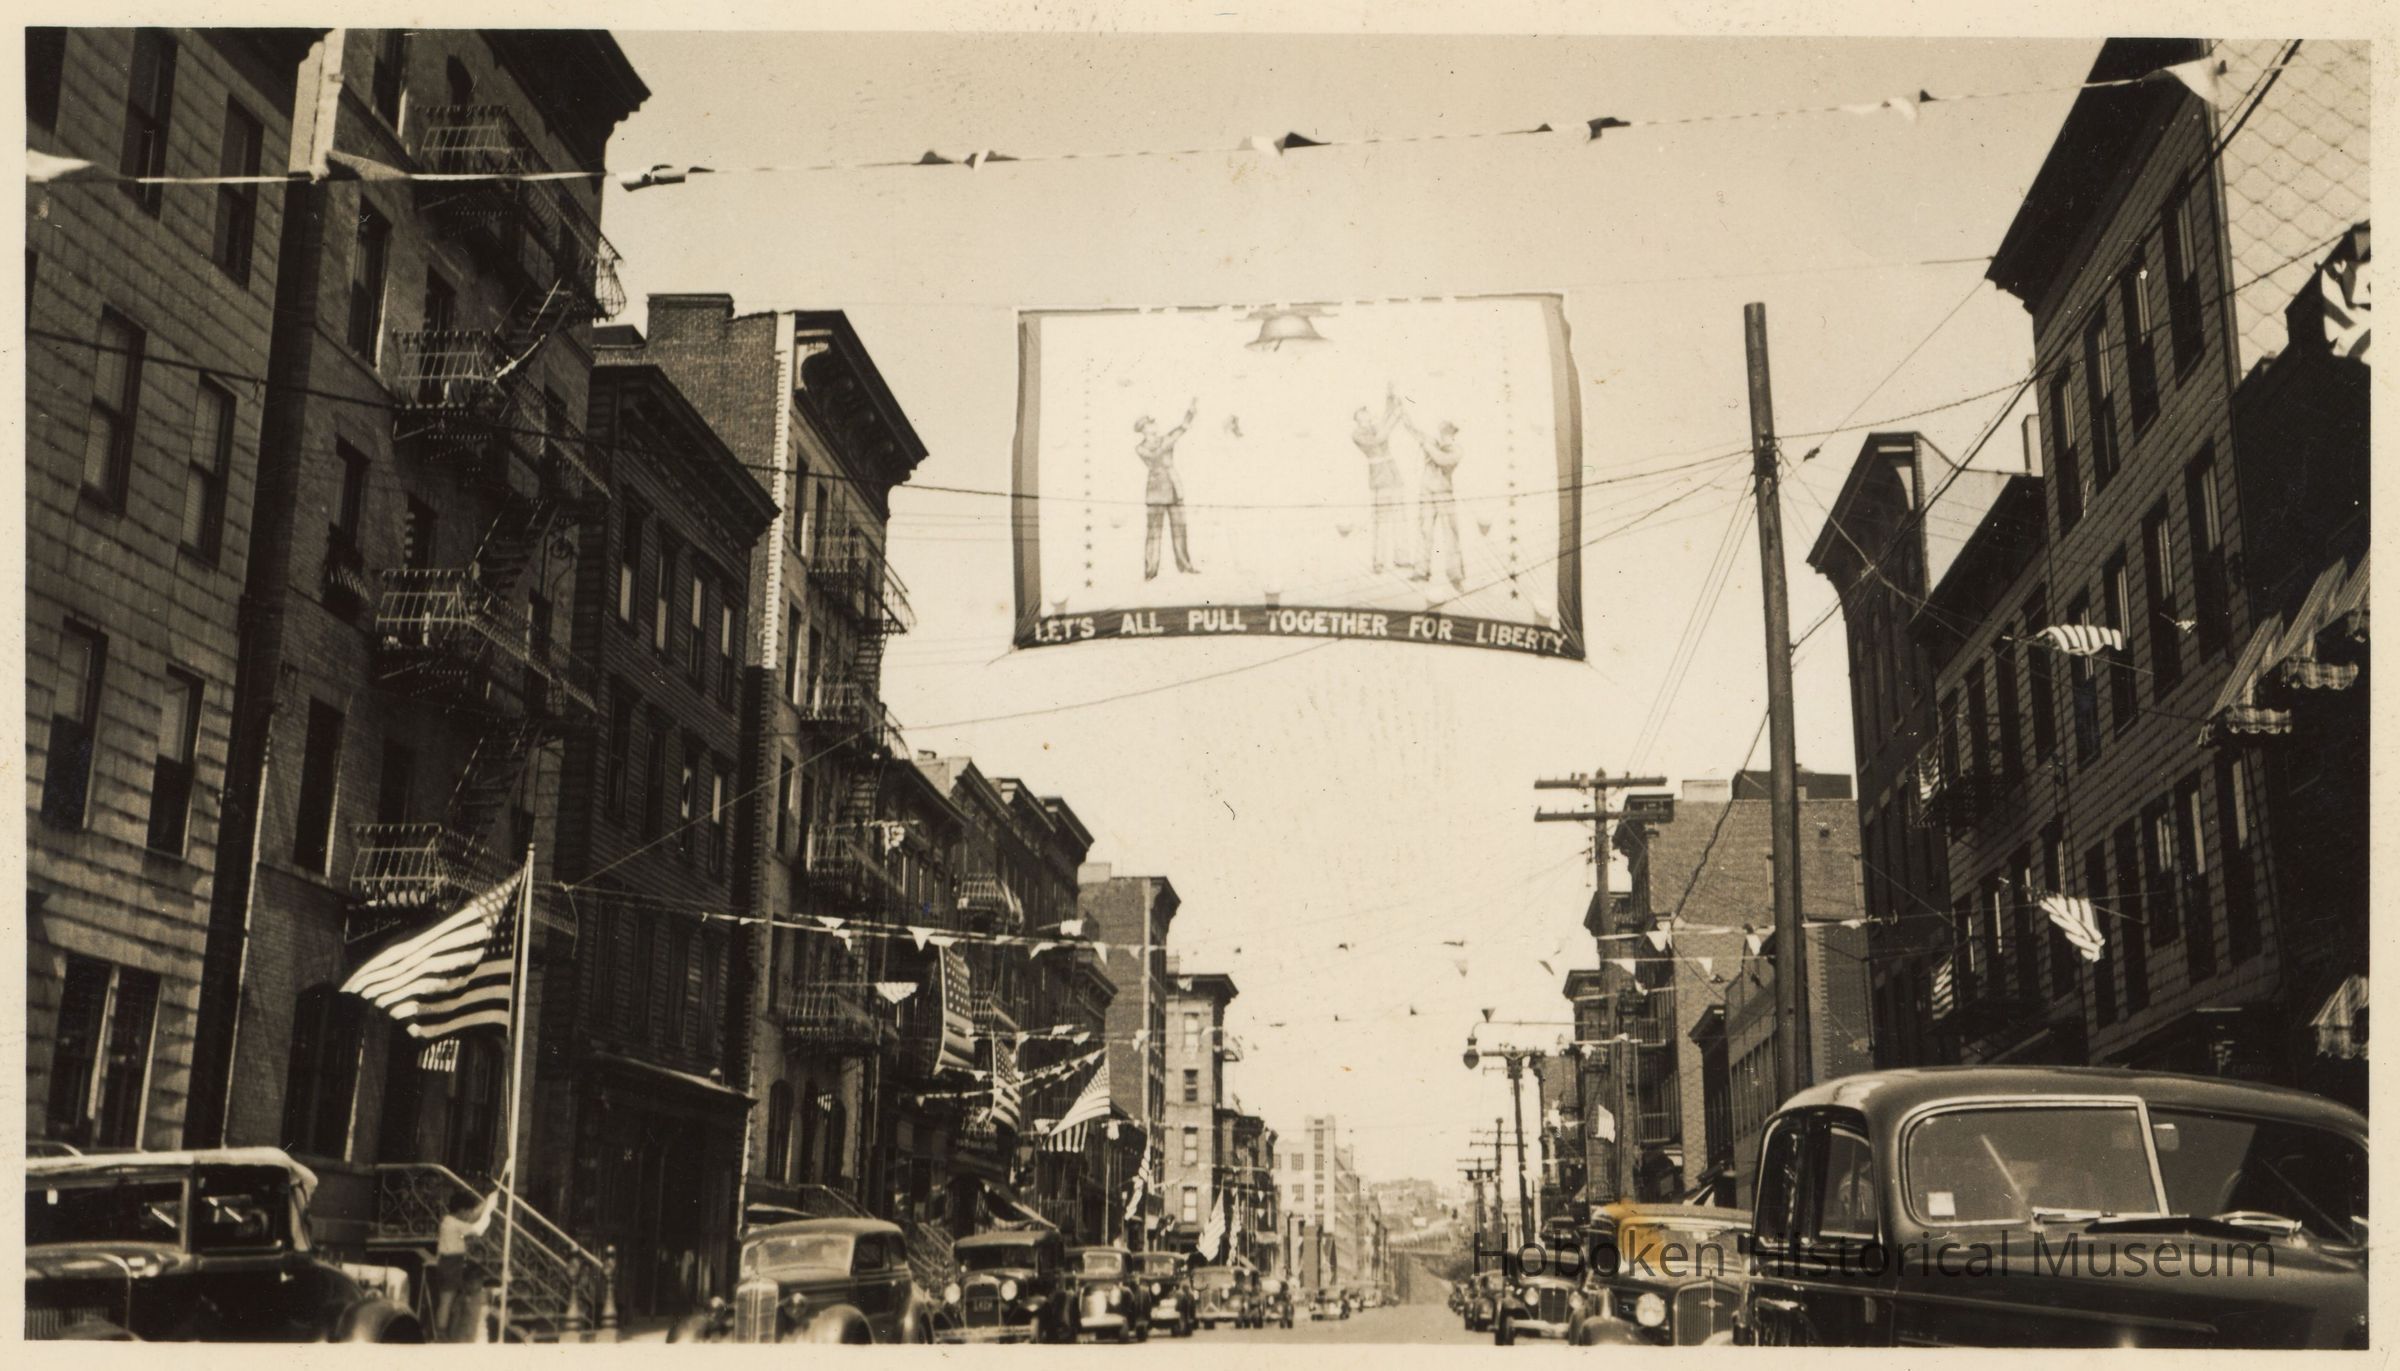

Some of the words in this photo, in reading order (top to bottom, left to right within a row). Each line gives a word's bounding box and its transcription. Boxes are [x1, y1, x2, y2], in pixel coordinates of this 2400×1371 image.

[1034, 618, 1095, 642] LET'S
[1120, 611, 1163, 635] ALL
[1188, 608, 1247, 632] PULL
[1267, 609, 1388, 637] TOGETHER
[1409, 616, 1452, 641] FOR
[1476, 622, 1567, 654] LIBERTY
